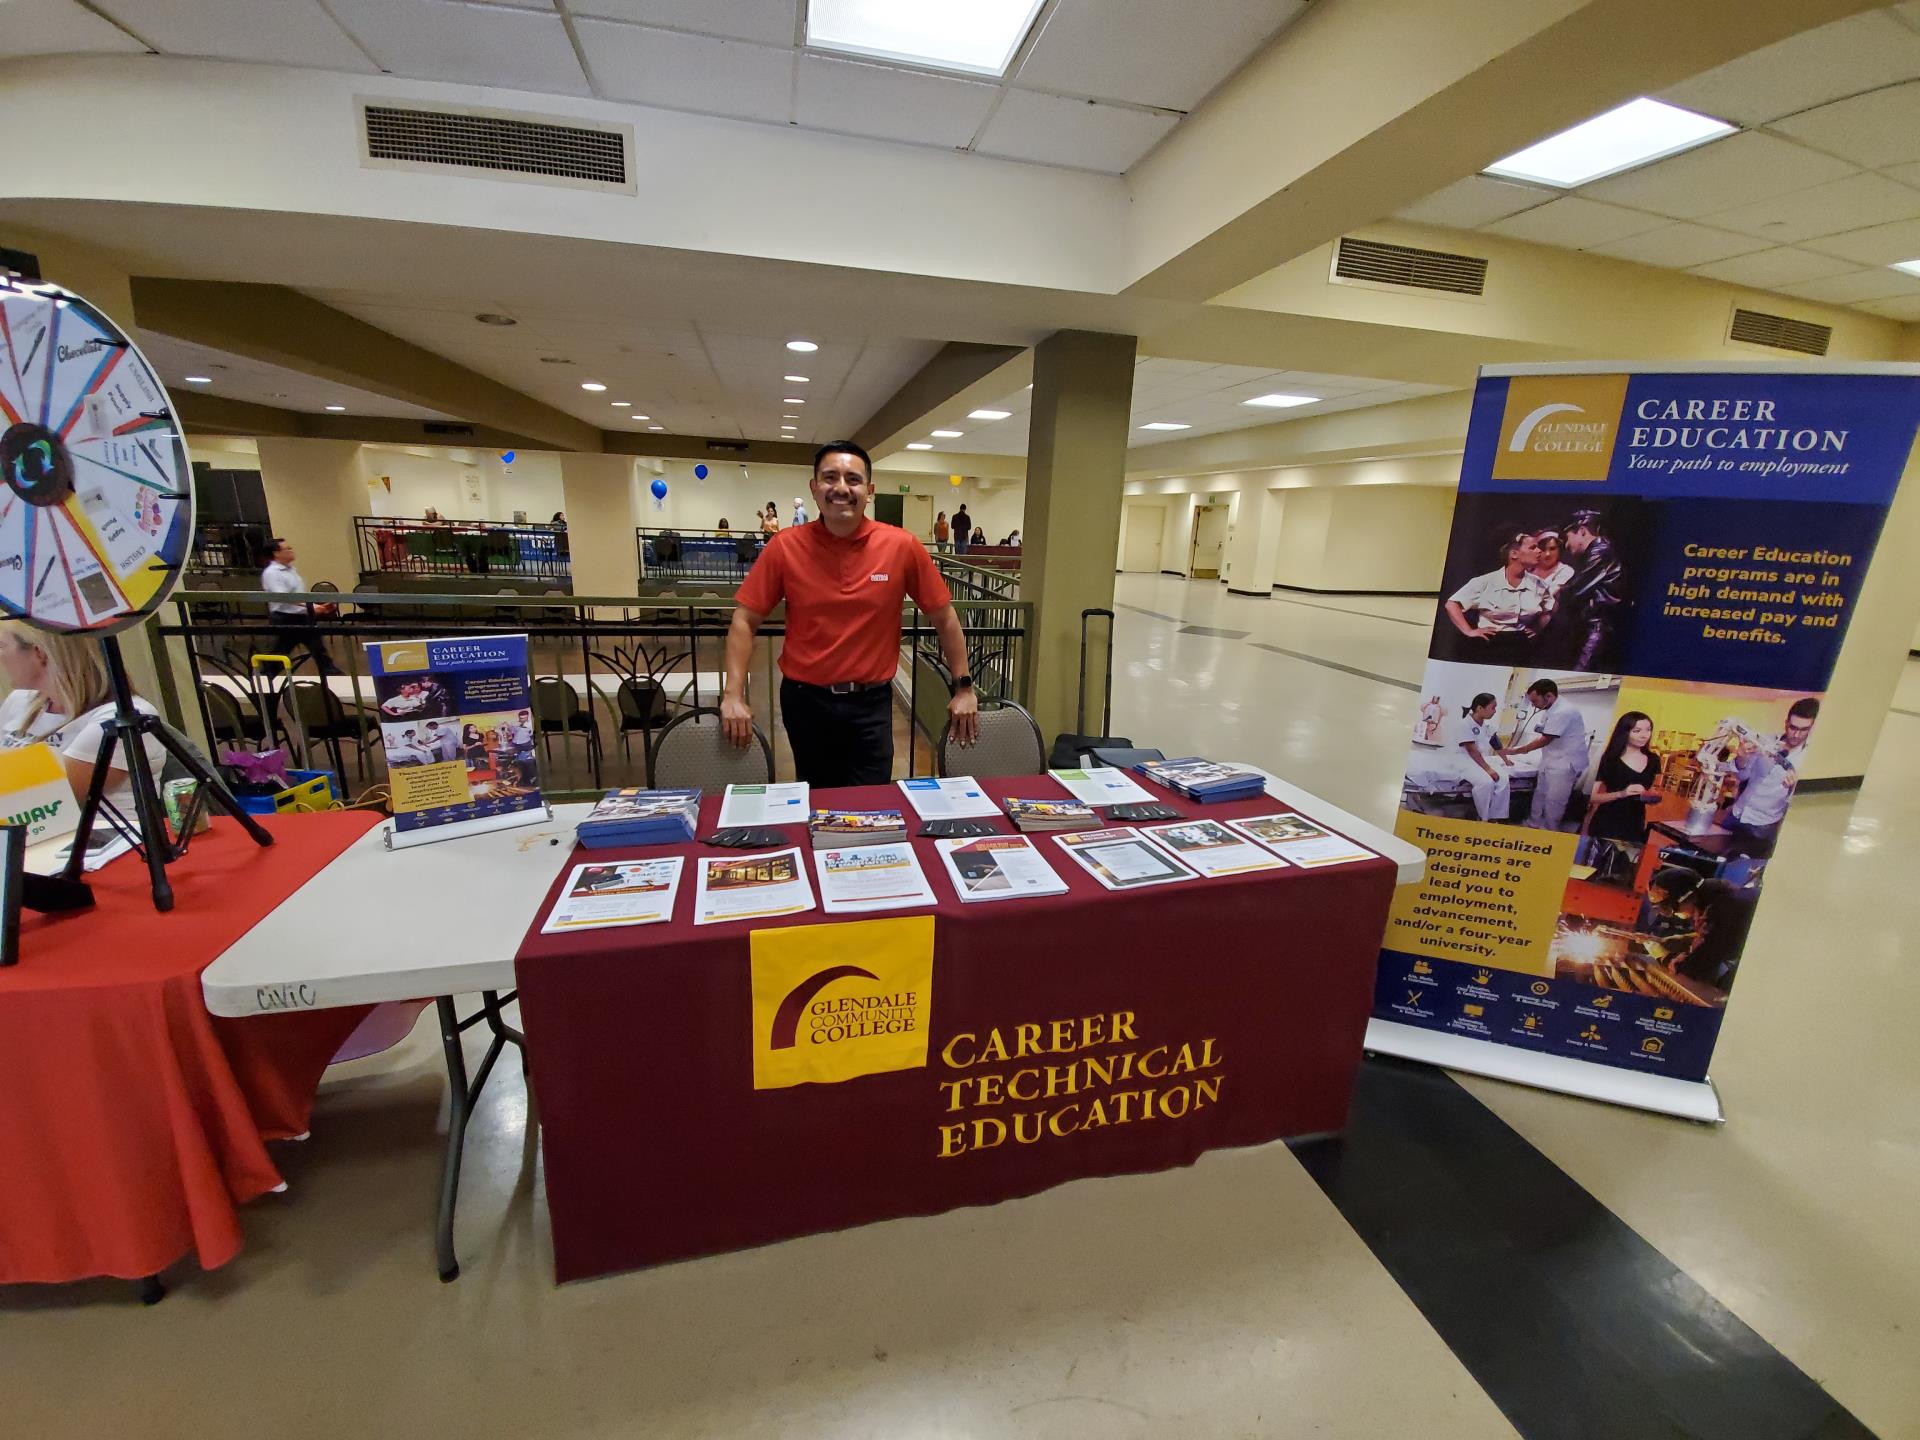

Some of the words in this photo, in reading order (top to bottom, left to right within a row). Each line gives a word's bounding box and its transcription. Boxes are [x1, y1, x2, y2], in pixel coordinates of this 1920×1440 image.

[1637, 399, 1776, 423] CAREER
[1534, 440, 1604, 452] COLLEGE
[1630, 427, 1849, 452] EDUCATION
[1627, 454, 1669, 470] Your
[1670, 455, 1712, 473] path
[1717, 457, 1735, 471] to
[1738, 458, 1850, 477] employment
[1683, 543, 1748, 560] Career
[1752, 546, 1852, 567] Education
[1683, 566, 1778, 584] programs
[1784, 573, 1816, 585] are
[1821, 571, 1840, 587] in
[1667, 583, 1711, 601] high
[1716, 585, 1796, 605] demand
[1801, 592, 1845, 608] with
[1663, 602, 1756, 622] increased
[1760, 611, 1797, 629] pay
[1801, 613, 1839, 628] and
[1702, 625, 1787, 645] benefits.
[432, 645, 480, 654] CAREER
[433, 650, 506, 661] EDUCATION
[8, 800, 63, 826] WAY
[31, 825, 46, 835] go
[1415, 826, 1460, 844] These
[1464, 836, 1553, 856] specialized
[1426, 846, 1502, 864] programs
[1506, 857, 1532, 869] are
[1430, 861, 1500, 881] designed
[1505, 870, 1521, 883] to
[1429, 876, 1461, 891] lead
[1465, 882, 1494, 897] you
[1498, 886, 1515, 898] to
[1419, 891, 1518, 916] employment,
[1412, 906, 1518, 931] advancement,
[1393, 917, 1443, 934] and/or
[1446, 926, 1455, 935] a
[1458, 925, 1533, 948] four-year
[1419, 935, 1497, 957] university.
[811, 991, 918, 1016] GLENDALE
[810, 1006, 917, 1030] COMMUNITY
[810, 1017, 916, 1046] COLLEGE
[941, 1011, 1140, 1071] CAREER
[938, 1038, 1224, 1113] TECHNICAL
[936, 1075, 1227, 1159] EDUCATION
